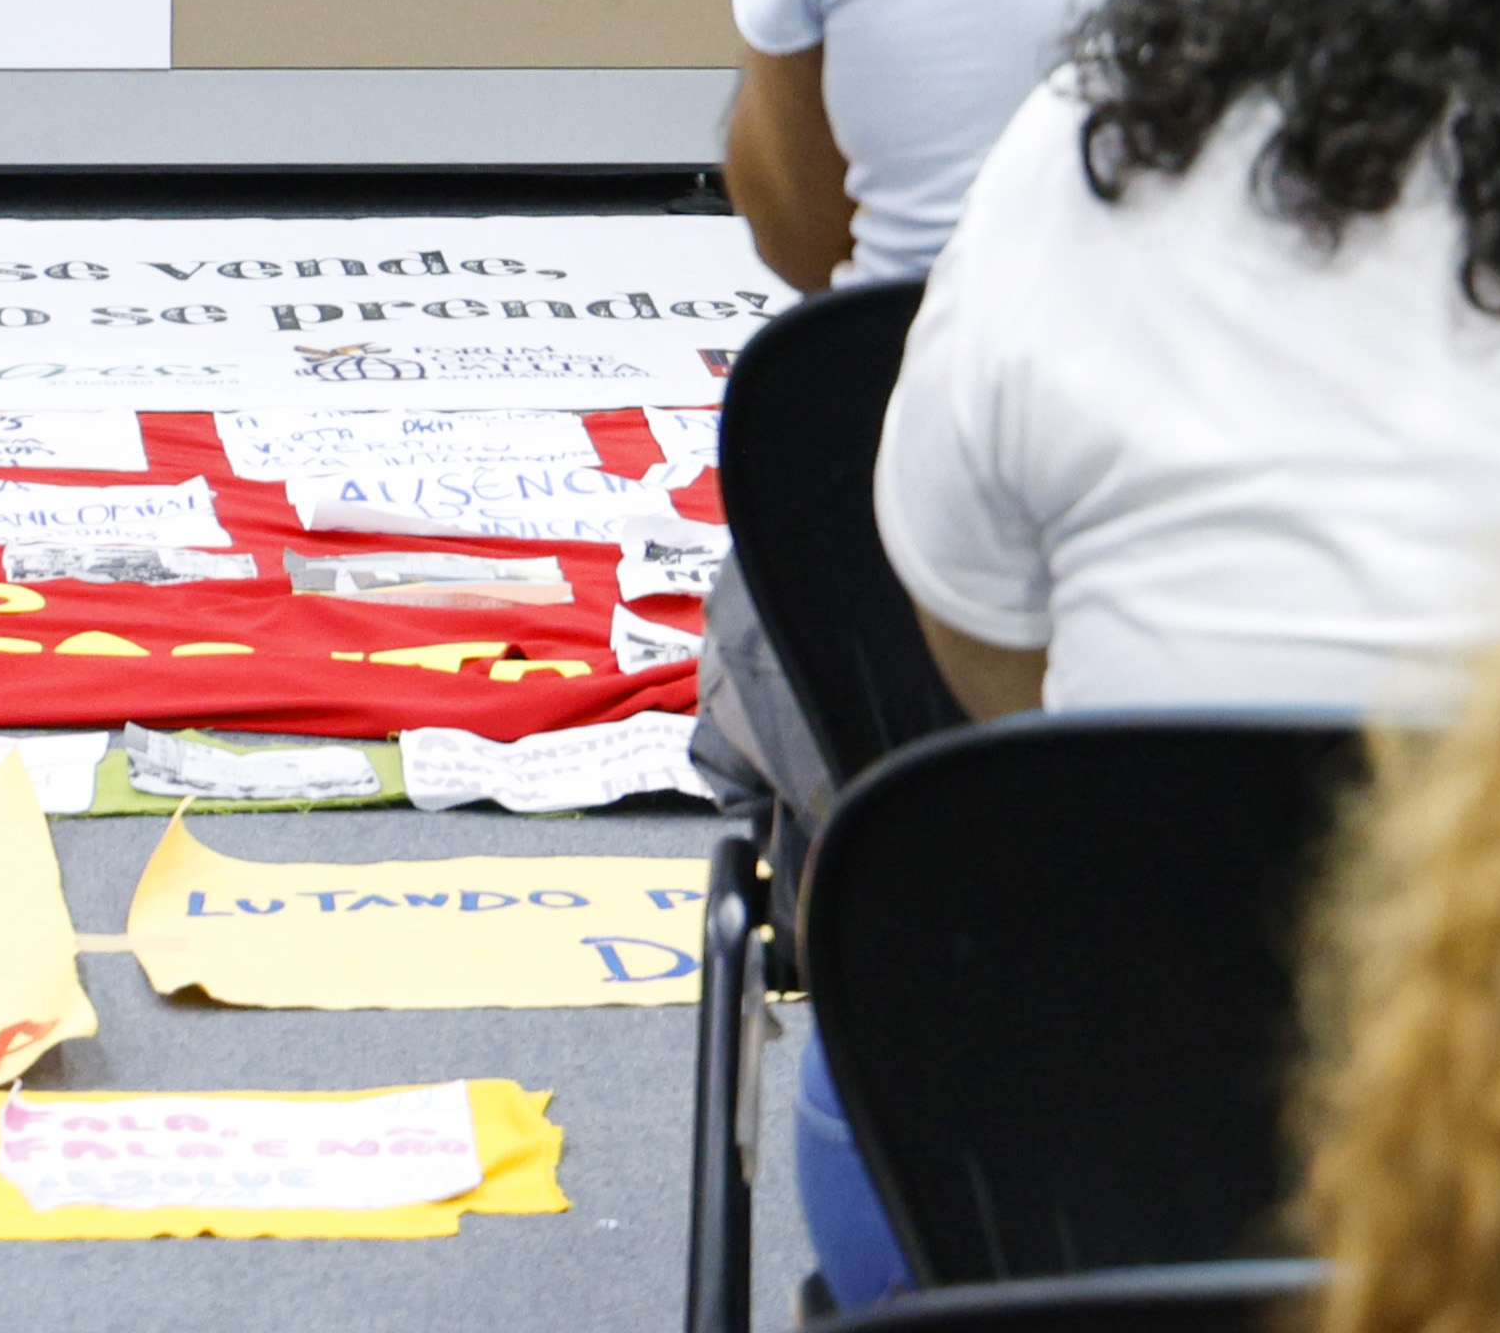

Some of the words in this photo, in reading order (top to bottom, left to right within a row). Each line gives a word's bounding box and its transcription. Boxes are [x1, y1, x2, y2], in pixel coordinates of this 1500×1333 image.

[138, 249, 569, 282] vende,
[90, 295, 230, 328] se
[185, 888, 592, 917] LUTANDO
